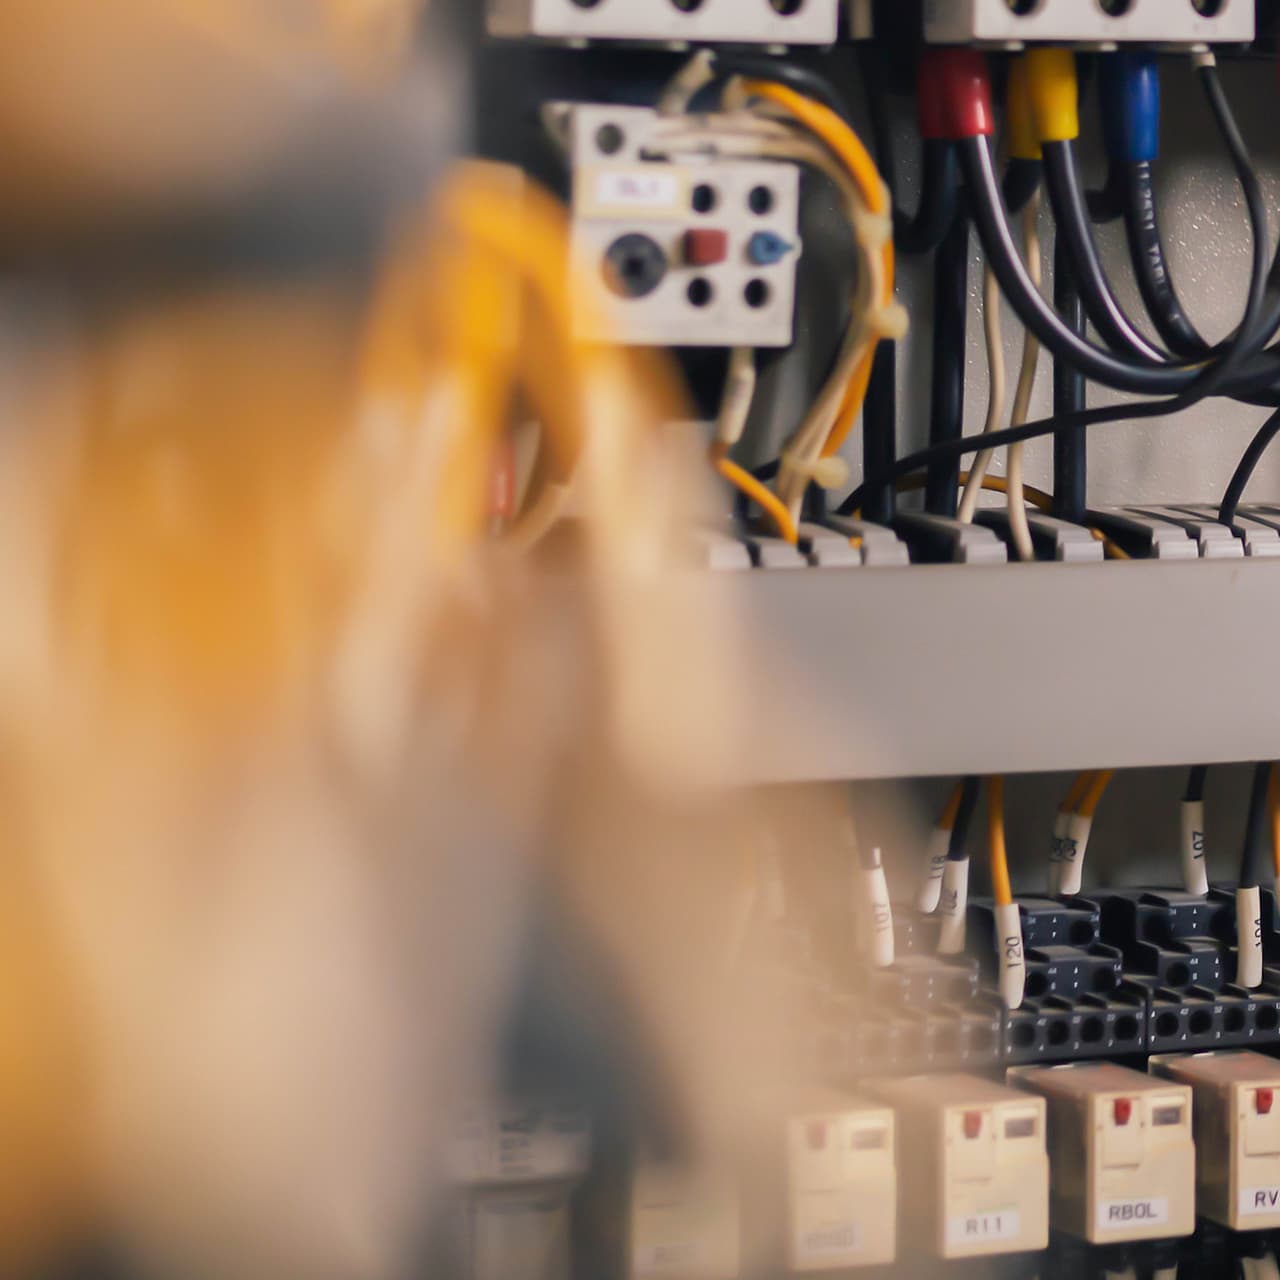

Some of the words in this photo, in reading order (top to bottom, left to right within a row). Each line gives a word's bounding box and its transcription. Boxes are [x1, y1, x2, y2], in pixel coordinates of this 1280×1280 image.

[1192, 830, 1205, 861] 107
[1005, 935, 1023, 969] 120
[1108, 1202, 1158, 1221] RBOL
[965, 1216, 1003, 1234] R11
